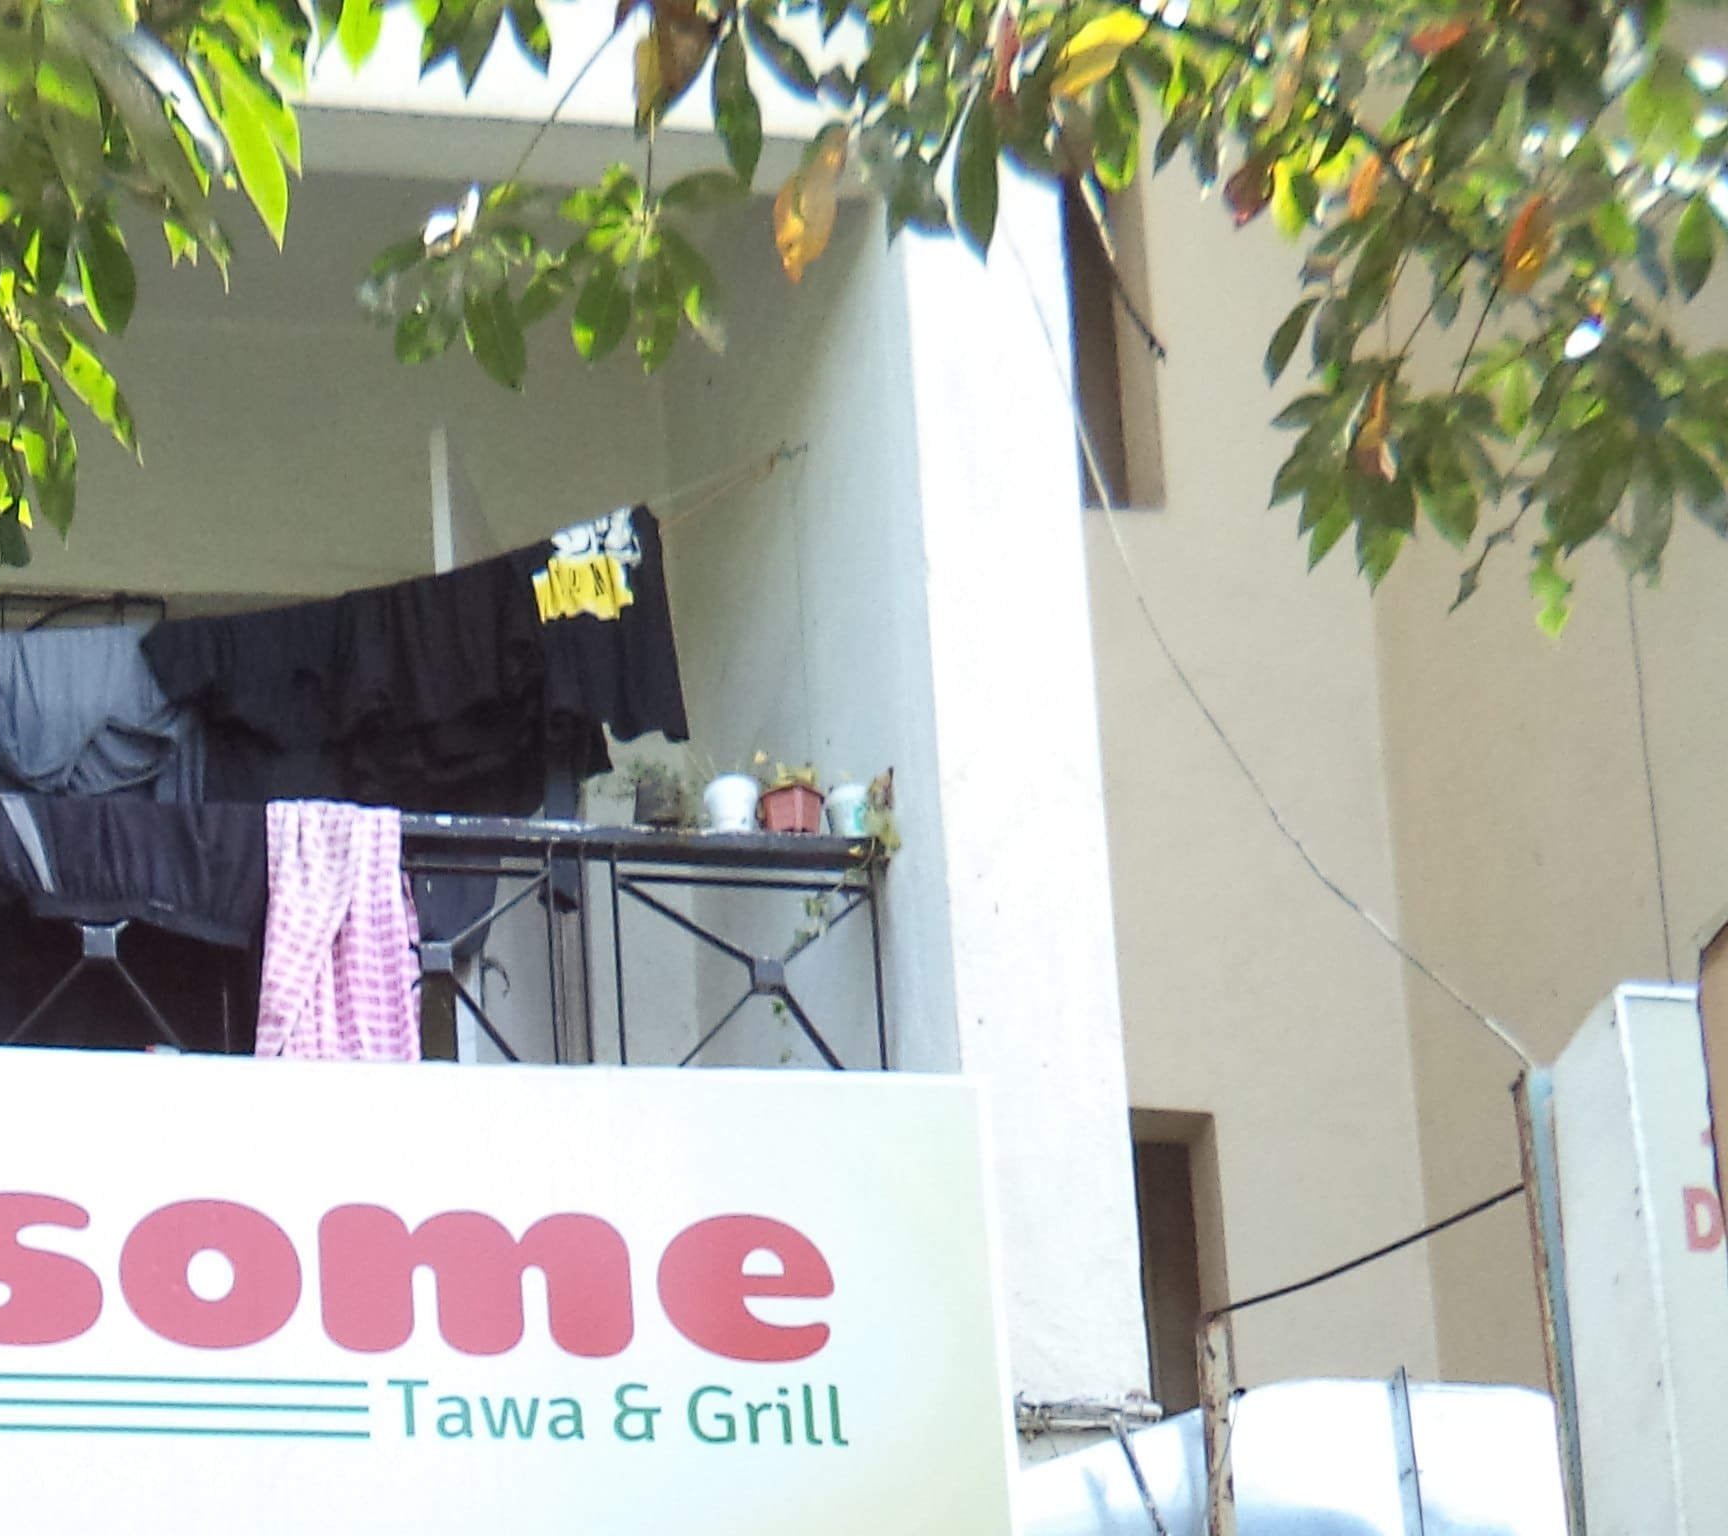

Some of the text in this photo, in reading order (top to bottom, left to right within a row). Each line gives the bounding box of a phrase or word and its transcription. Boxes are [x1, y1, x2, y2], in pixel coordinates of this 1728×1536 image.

[386, 1378, 850, 1447] Tawa & Grill
